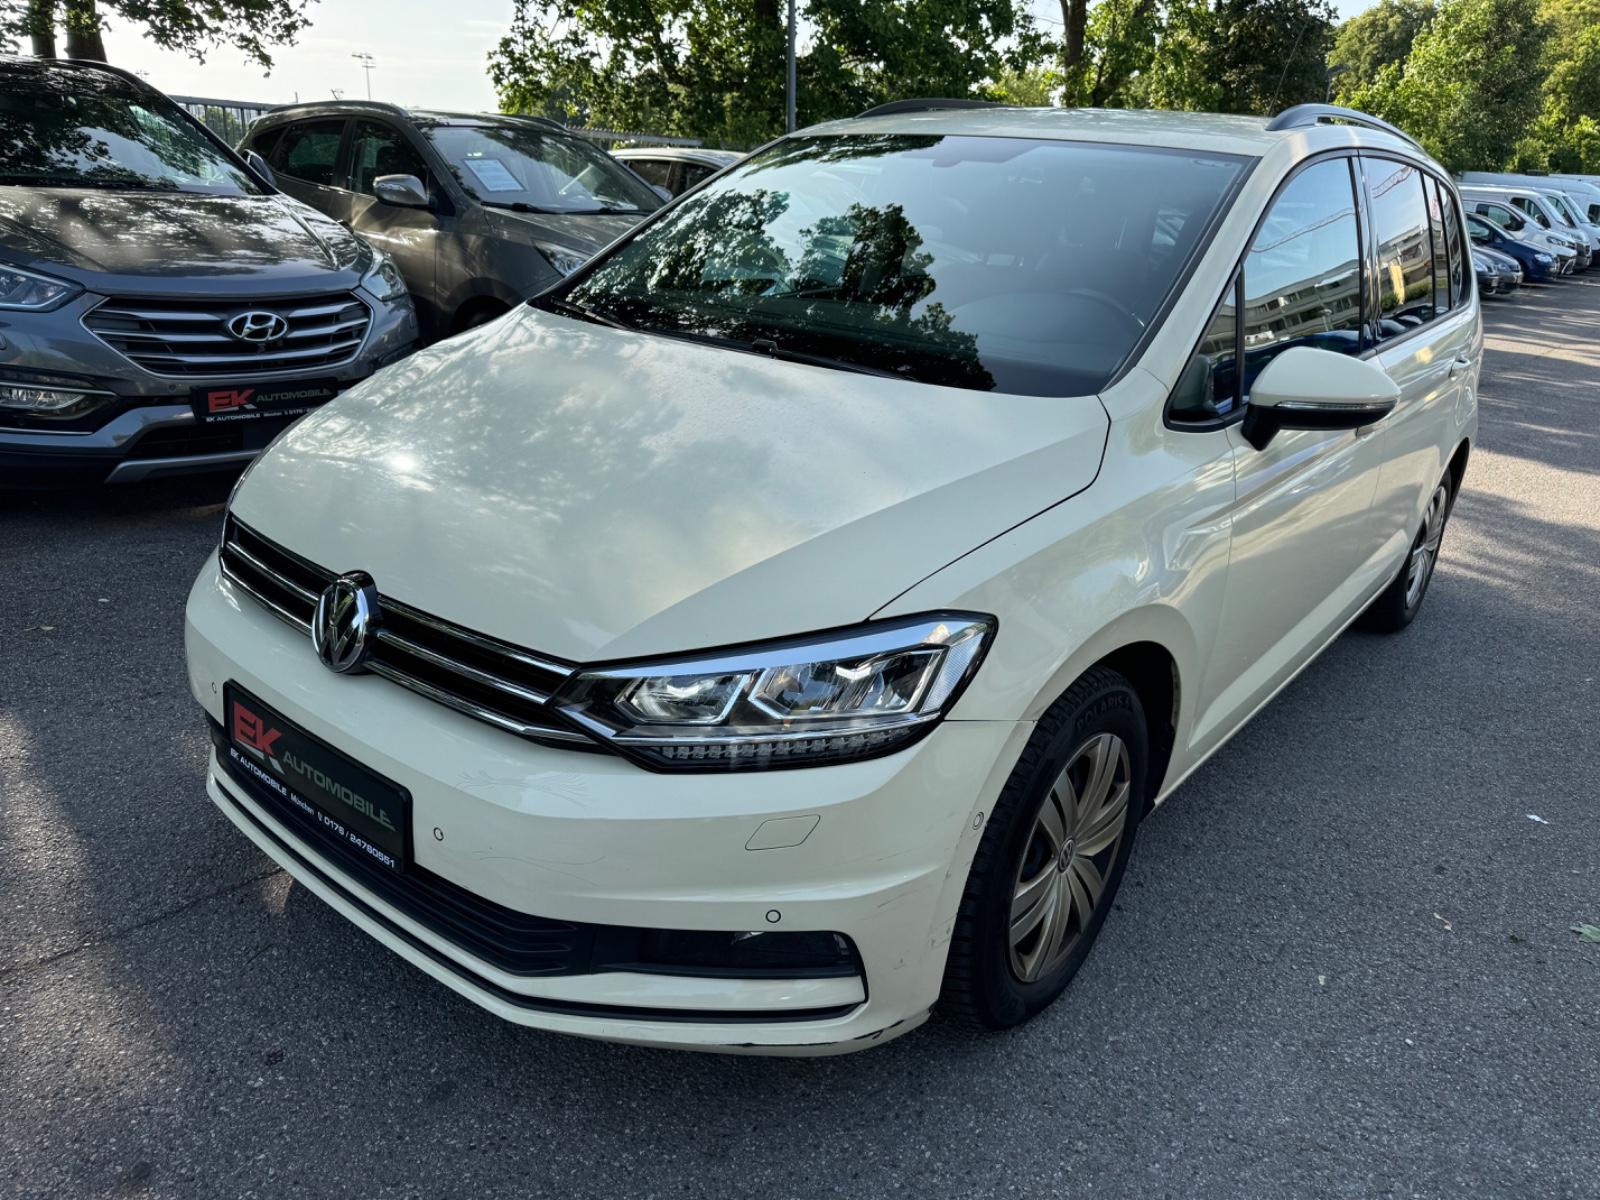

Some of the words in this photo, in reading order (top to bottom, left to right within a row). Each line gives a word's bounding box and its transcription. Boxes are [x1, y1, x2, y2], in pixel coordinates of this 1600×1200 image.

[208, 389, 257, 412] EK
[216, 412, 260, 421] AUTOMOBILE
[234, 701, 285, 775] EK
[283, 751, 395, 832] AUTOMOBILE
[240, 756, 287, 796] AUTOMOBILE
